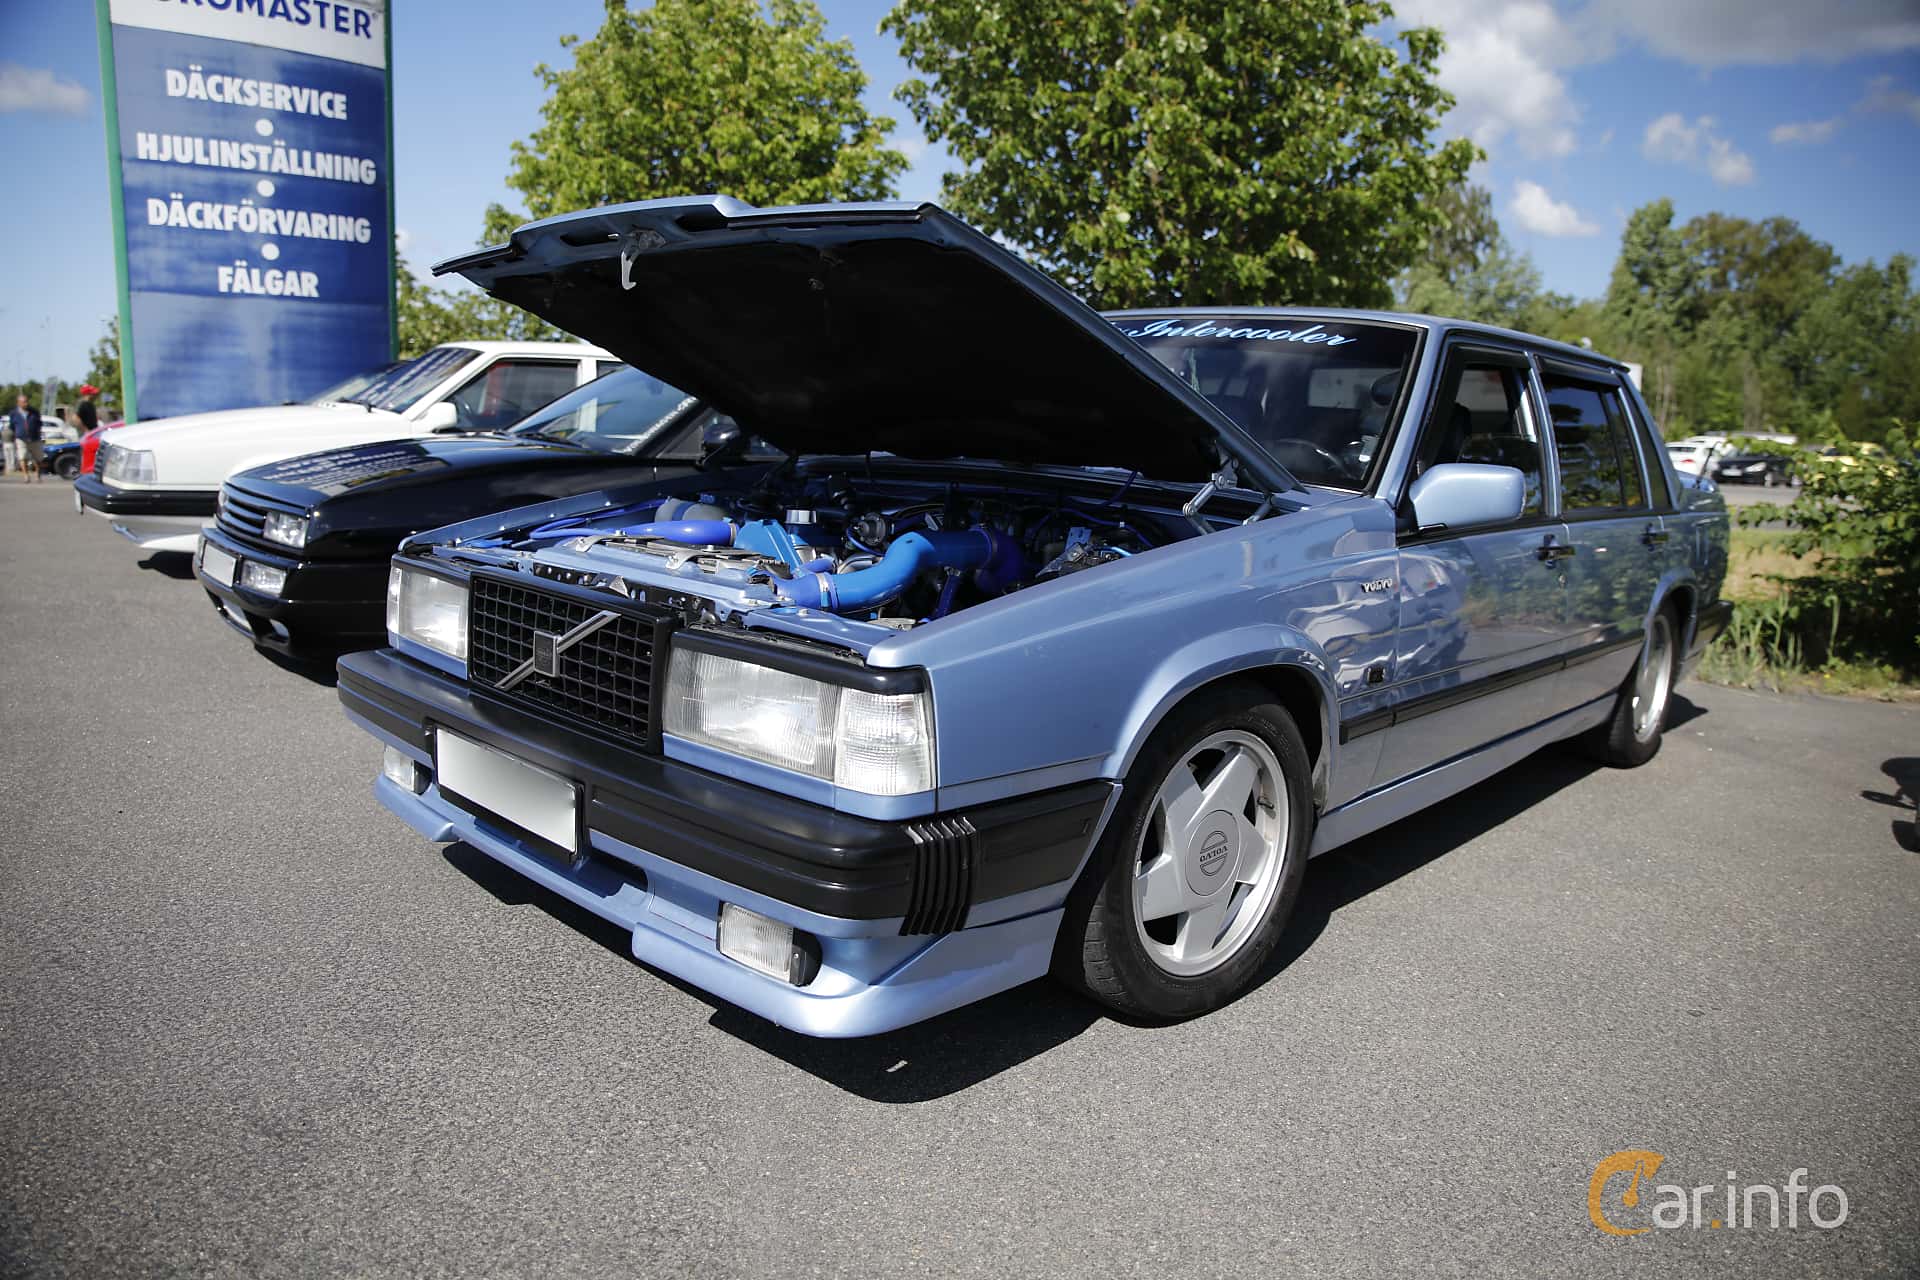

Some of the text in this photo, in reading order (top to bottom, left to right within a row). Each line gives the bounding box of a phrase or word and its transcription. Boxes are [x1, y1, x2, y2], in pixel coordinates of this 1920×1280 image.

[165, 64, 347, 120] DÄCKSERVICE
[136, 132, 376, 185] HJULINSTÄLLNING
[147, 193, 371, 244] DÄCKFÖRVARING
[218, 260, 319, 298] FÄLGAR
[1128, 319, 1357, 346] Intercooler
[1200, 845, 1228, 862] VOLVO
